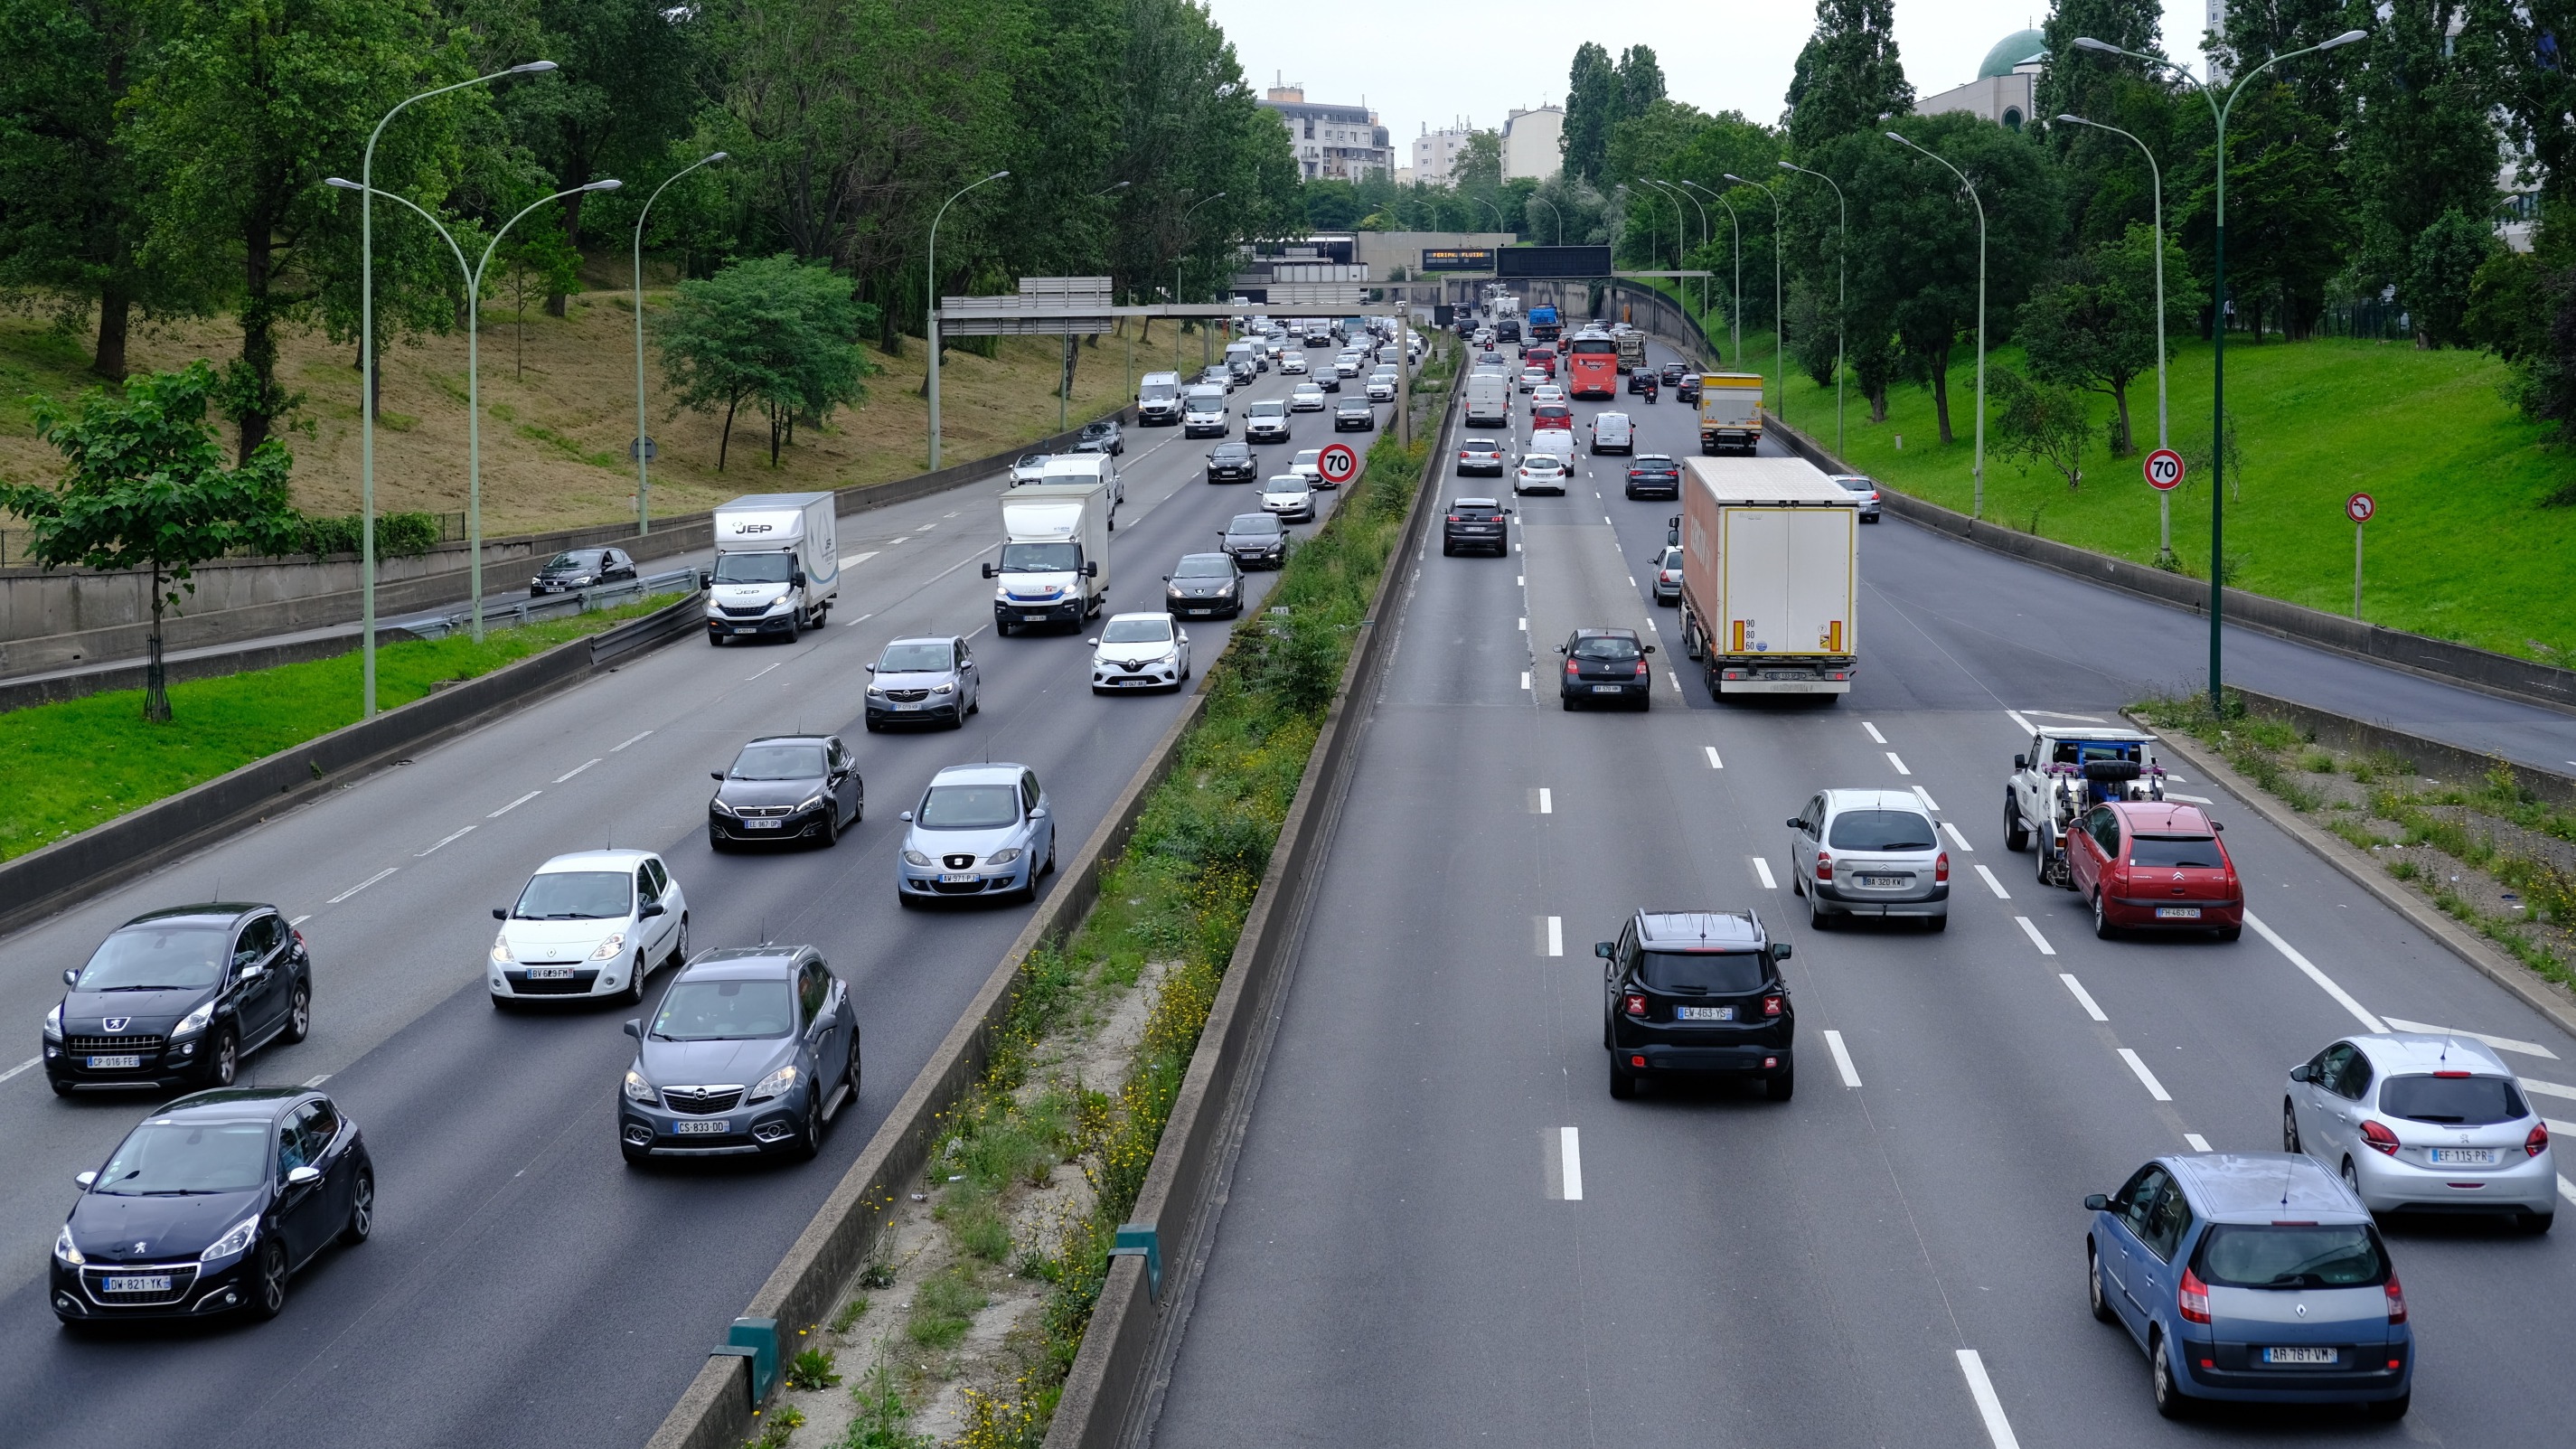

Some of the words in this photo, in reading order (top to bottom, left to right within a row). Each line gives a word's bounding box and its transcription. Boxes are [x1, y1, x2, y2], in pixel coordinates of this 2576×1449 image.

[1326, 455, 1349, 471] 70
[2153, 461, 2176, 477] 70
[736, 524, 773, 534] JEP
[1745, 619, 1755, 627] 90
[1745, 630, 1755, 639] 80
[1745, 642, 1754, 650] 60
[1684, 1008, 1726, 1018] EW-463-YS
[93, 1057, 133, 1067] CP-016-FE
[680, 1122, 724, 1132] CS-833-DD
[2439, 1150, 2487, 1162] EF-115-PR
[110, 1278, 163, 1290] DW-821-YK
[2272, 1348, 2328, 1360] AR-787-VM
